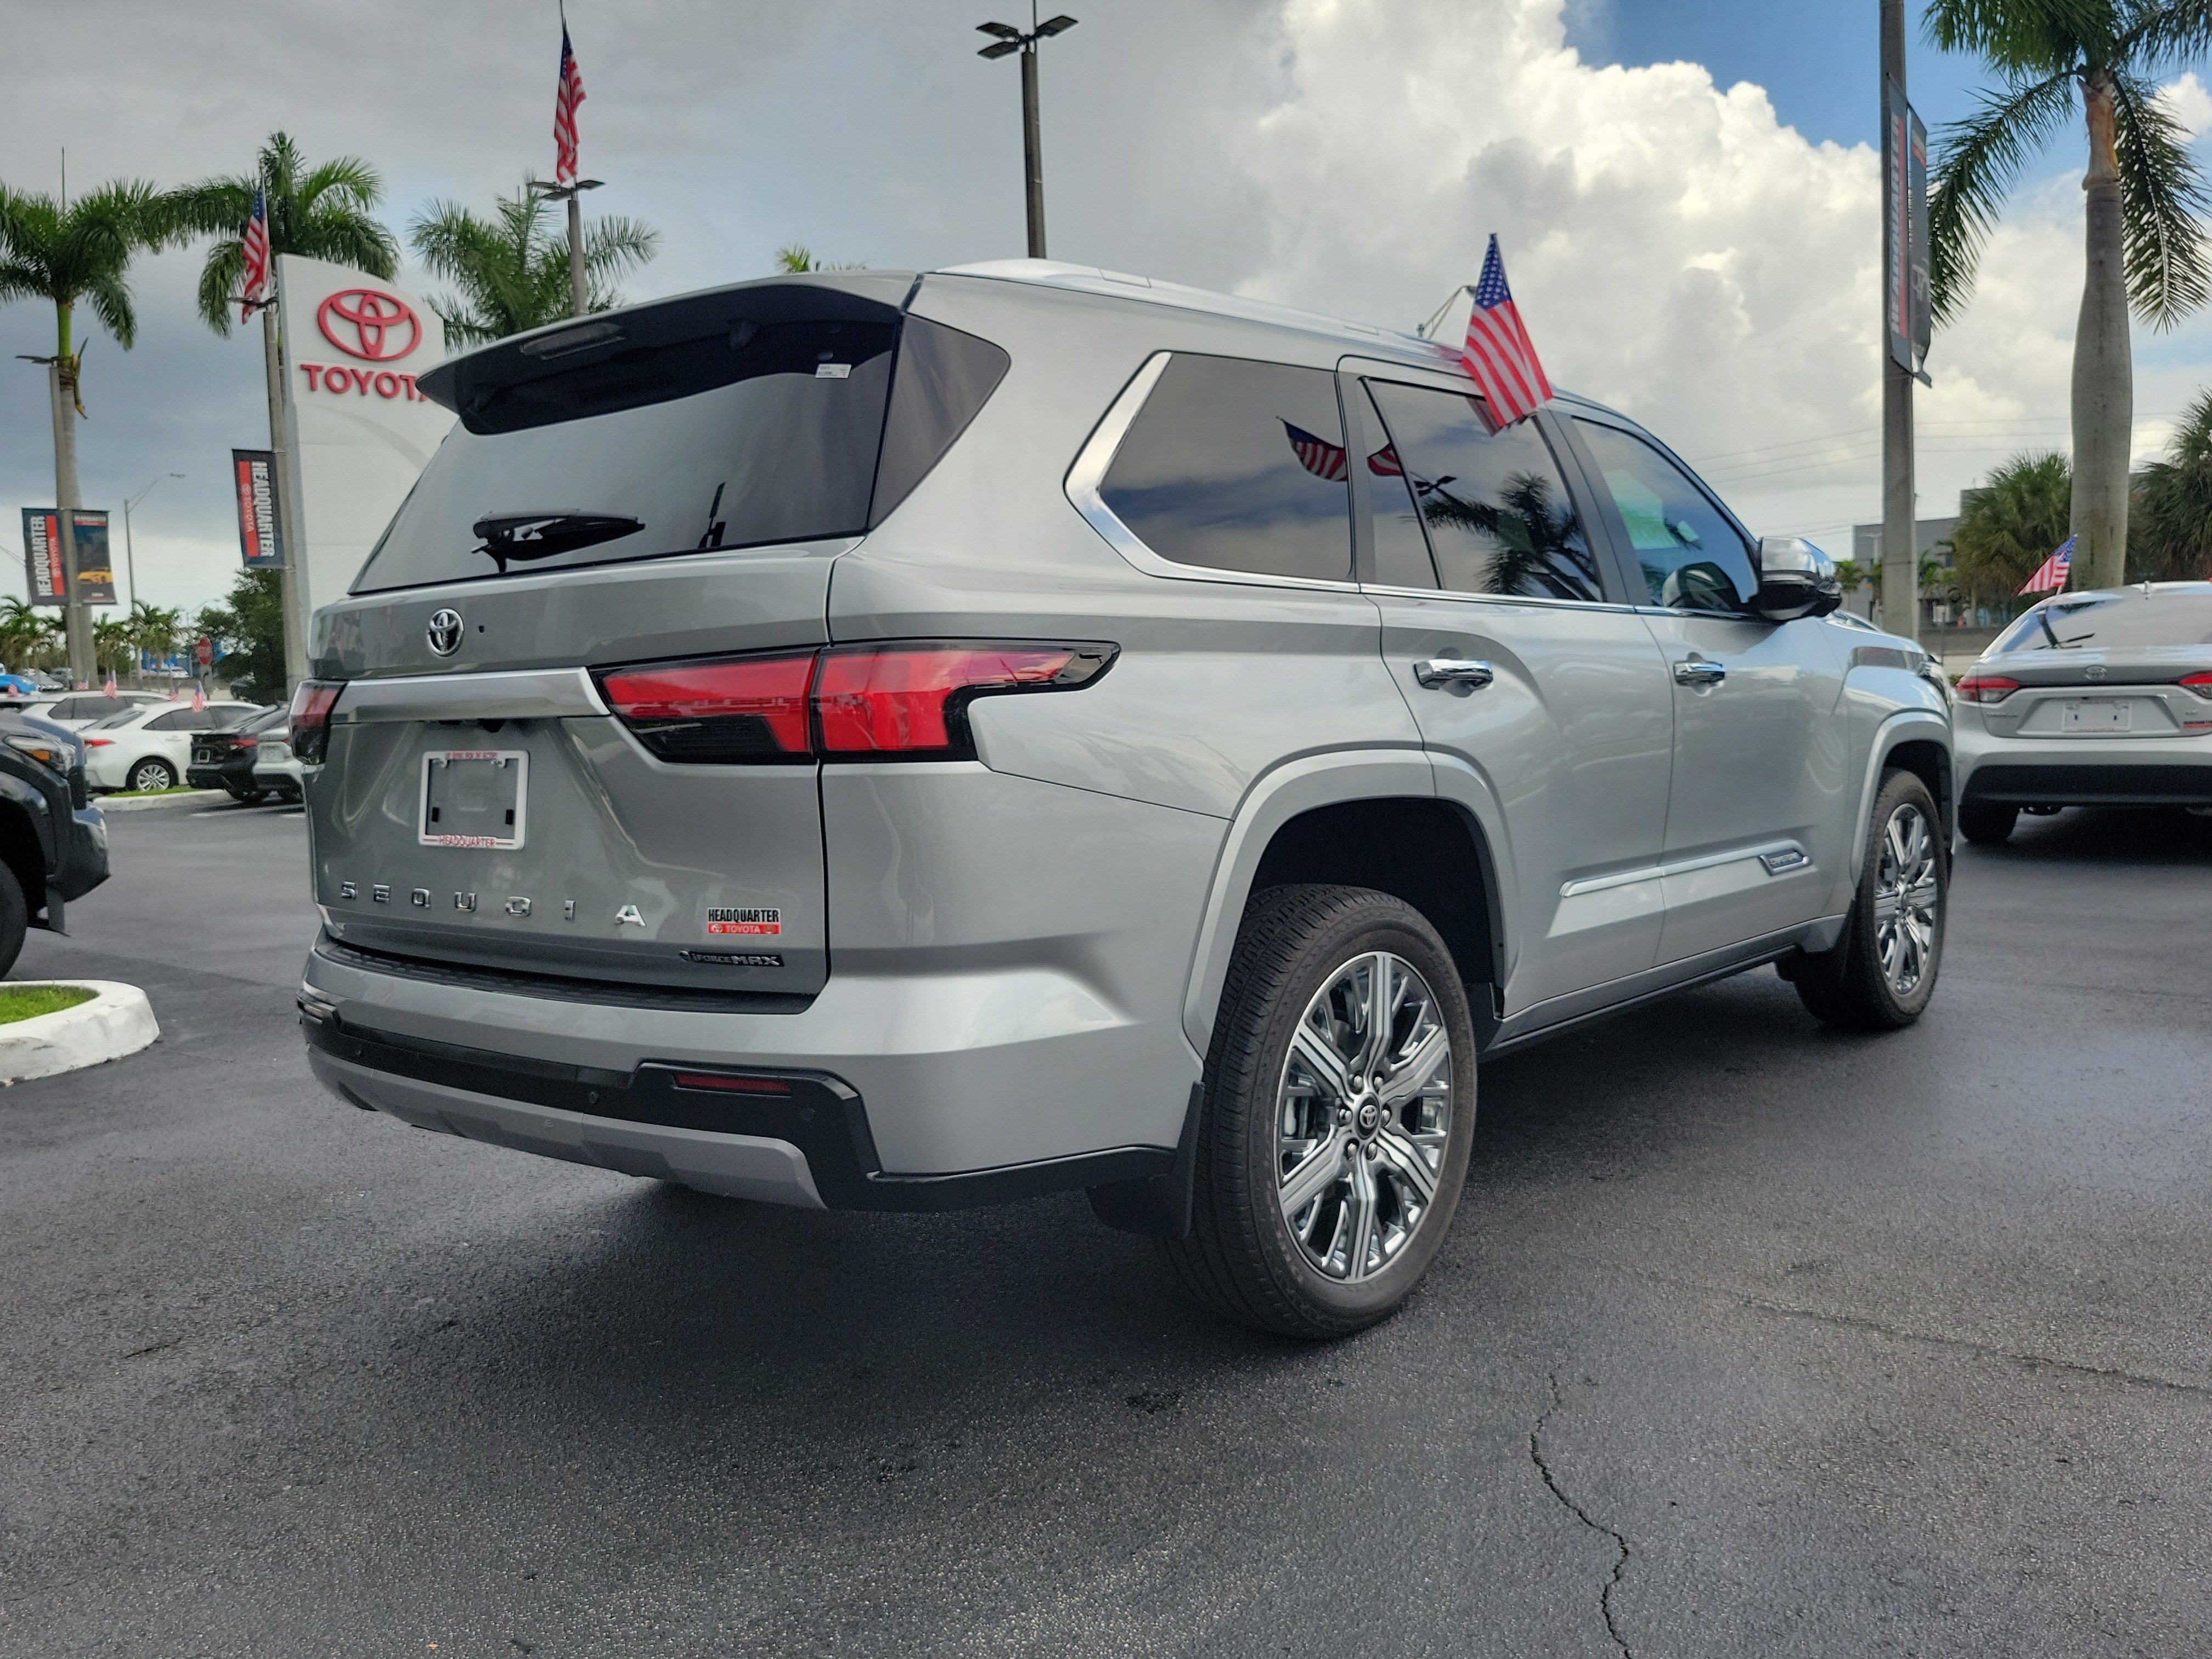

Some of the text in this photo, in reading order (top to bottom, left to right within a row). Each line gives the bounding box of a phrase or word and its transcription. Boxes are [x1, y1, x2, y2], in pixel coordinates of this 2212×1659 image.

[301, 364, 427, 402] TOYOT
[251, 461, 275, 557] HEADQUARTER
[31, 516, 54, 596] HEADQUARTER
[439, 835, 496, 847] HEADQUARTER
[341, 881, 646, 927] SEQUOIA
[708, 909, 780, 923] HEADQUARTER
[726, 925, 761, 933] TOYOTA
